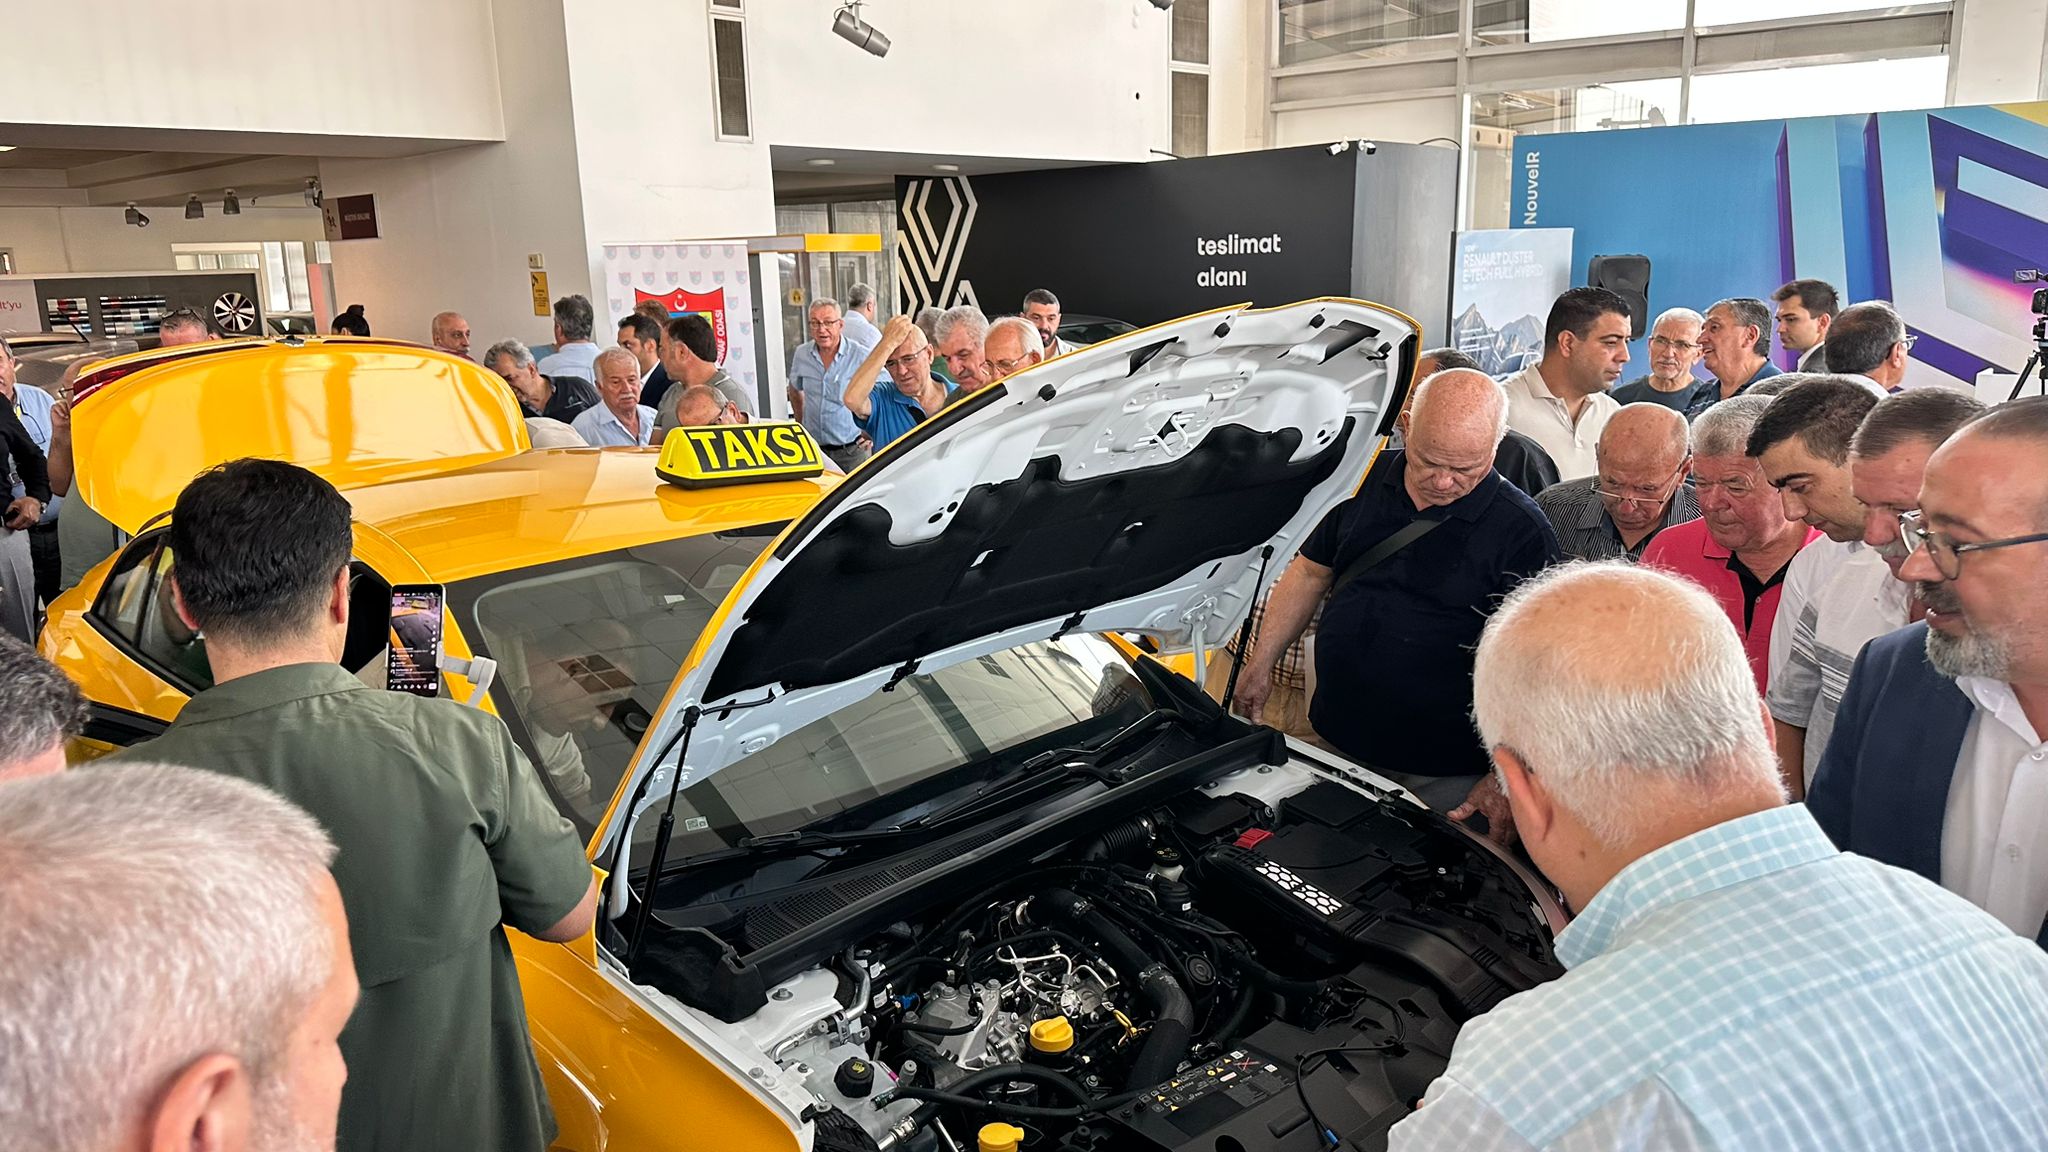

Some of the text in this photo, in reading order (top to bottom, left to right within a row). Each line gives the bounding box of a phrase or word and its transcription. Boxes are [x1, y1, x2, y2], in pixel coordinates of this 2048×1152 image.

[1197, 234, 1281, 255] teslimat
[1463, 250, 1535, 269] RENAULT DUSTER
[1197, 266, 1247, 287] alanı
